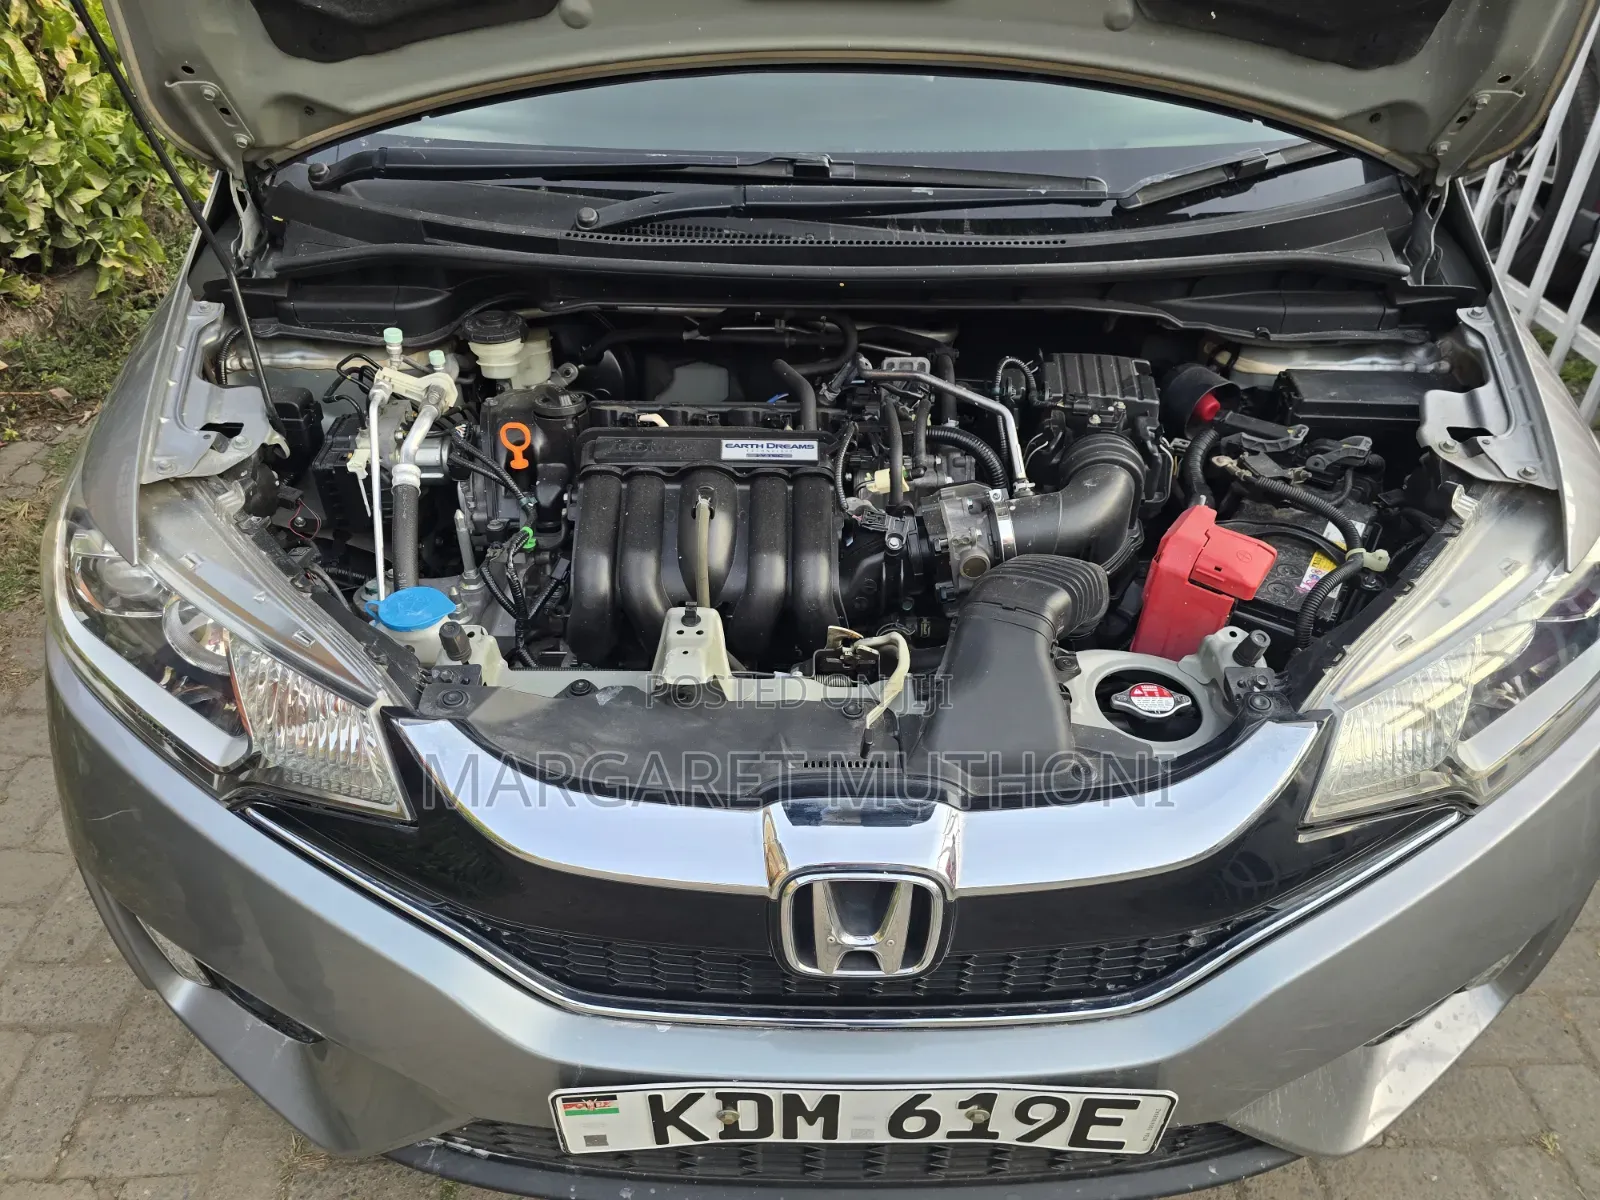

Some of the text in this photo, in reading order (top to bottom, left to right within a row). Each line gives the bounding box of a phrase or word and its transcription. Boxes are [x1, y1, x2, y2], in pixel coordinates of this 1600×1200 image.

[766, 442, 815, 450] DREAMS
[648, 1092, 842, 1146] KDM
[887, 1092, 1142, 1150] 619E
